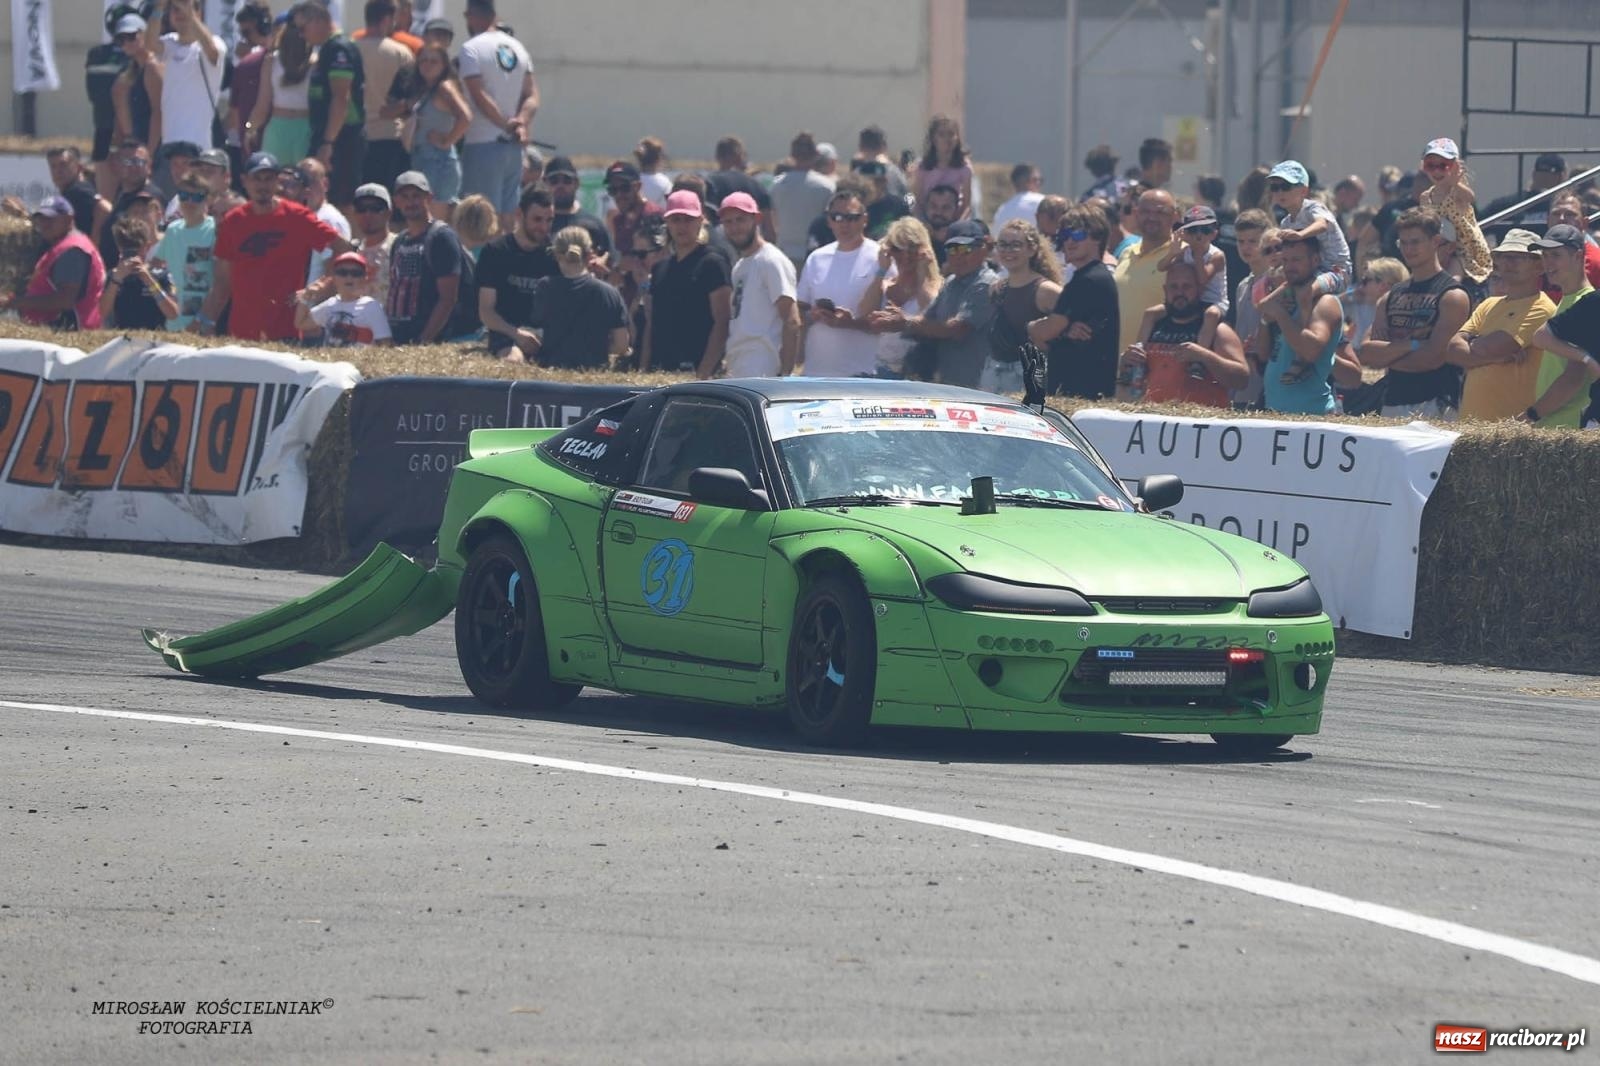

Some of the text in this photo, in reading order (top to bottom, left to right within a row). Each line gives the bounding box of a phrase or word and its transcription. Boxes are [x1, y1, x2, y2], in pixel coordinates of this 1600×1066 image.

[397, 413, 447, 431] AUTO
[954, 411, 973, 420] 74
[1126, 419, 1358, 472] AUTO FUS
[408, 451, 465, 472] GROU
[674, 504, 694, 520] 031
[1158, 510, 1310, 559] OUP
[645, 546, 695, 609] 31
